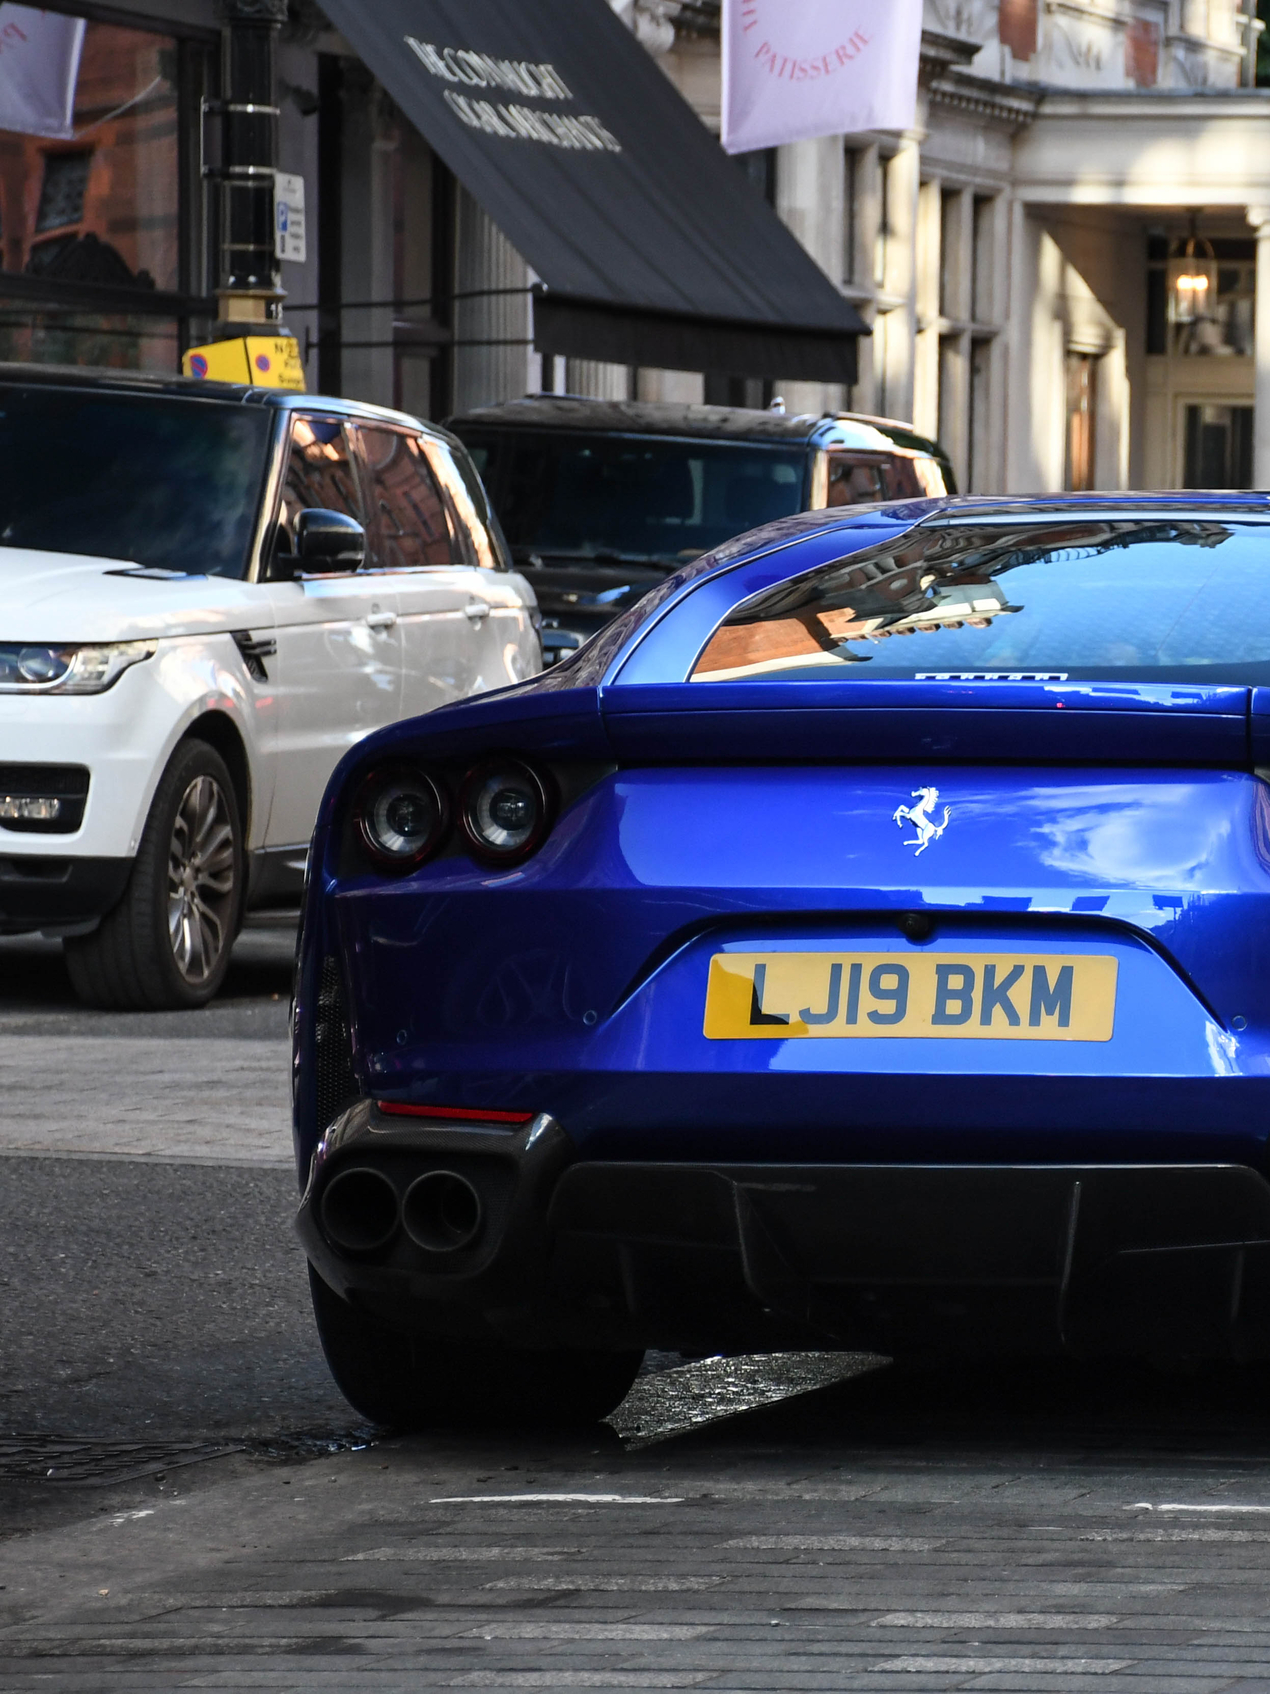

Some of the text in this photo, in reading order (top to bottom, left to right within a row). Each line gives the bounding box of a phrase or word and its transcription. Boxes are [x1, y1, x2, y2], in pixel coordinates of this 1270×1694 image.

[403, 34, 460, 82] THE
[755, 25, 874, 80] PATISSERIE
[442, 88, 623, 153] CIGAR MERCHANTS
[749, 962, 1075, 1028] LJ19 BKM
